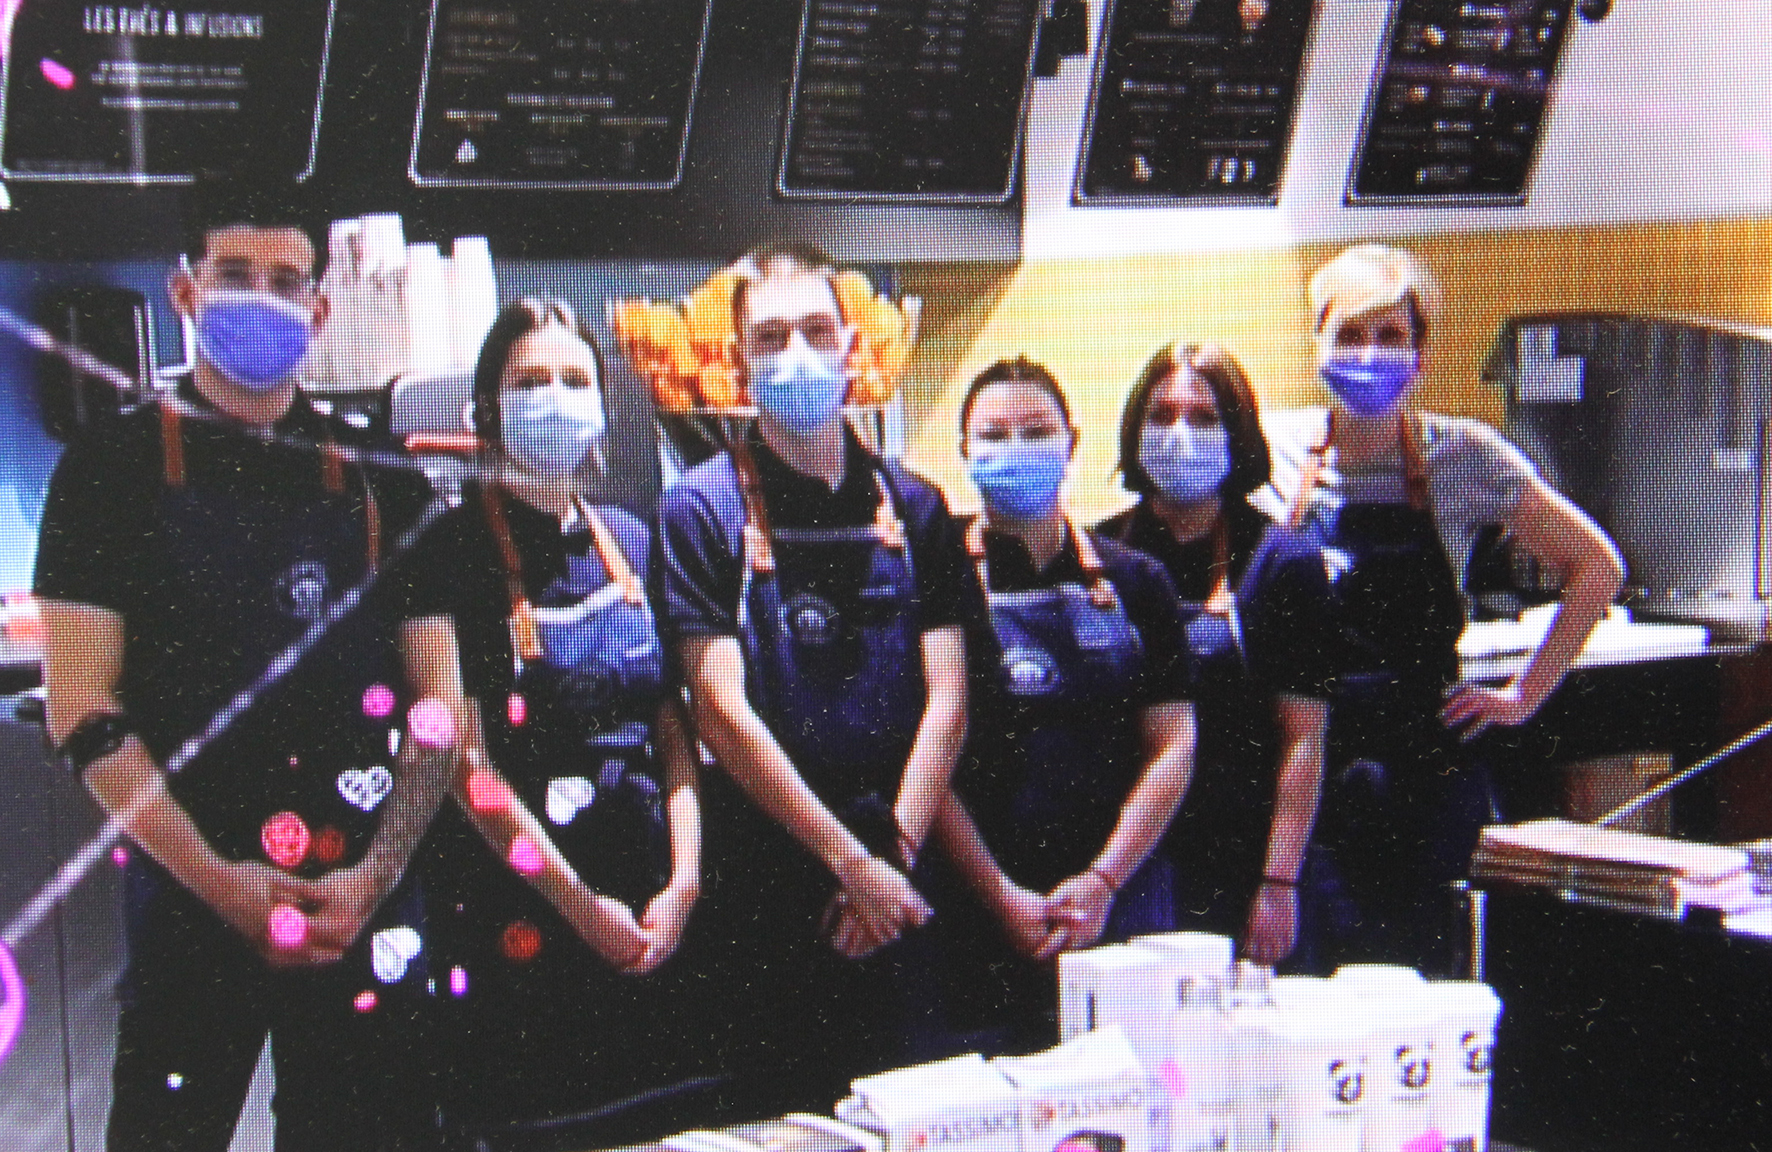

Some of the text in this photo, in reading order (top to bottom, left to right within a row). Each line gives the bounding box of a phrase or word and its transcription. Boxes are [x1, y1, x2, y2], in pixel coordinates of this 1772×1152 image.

[83, 7, 115, 34] LES
[119, 3, 160, 35] THÉS
[184, 13, 263, 38] INFUSIONS
[1058, 1087, 1143, 1120] TASSIMO
[929, 1111, 1019, 1145] TASSIMO
